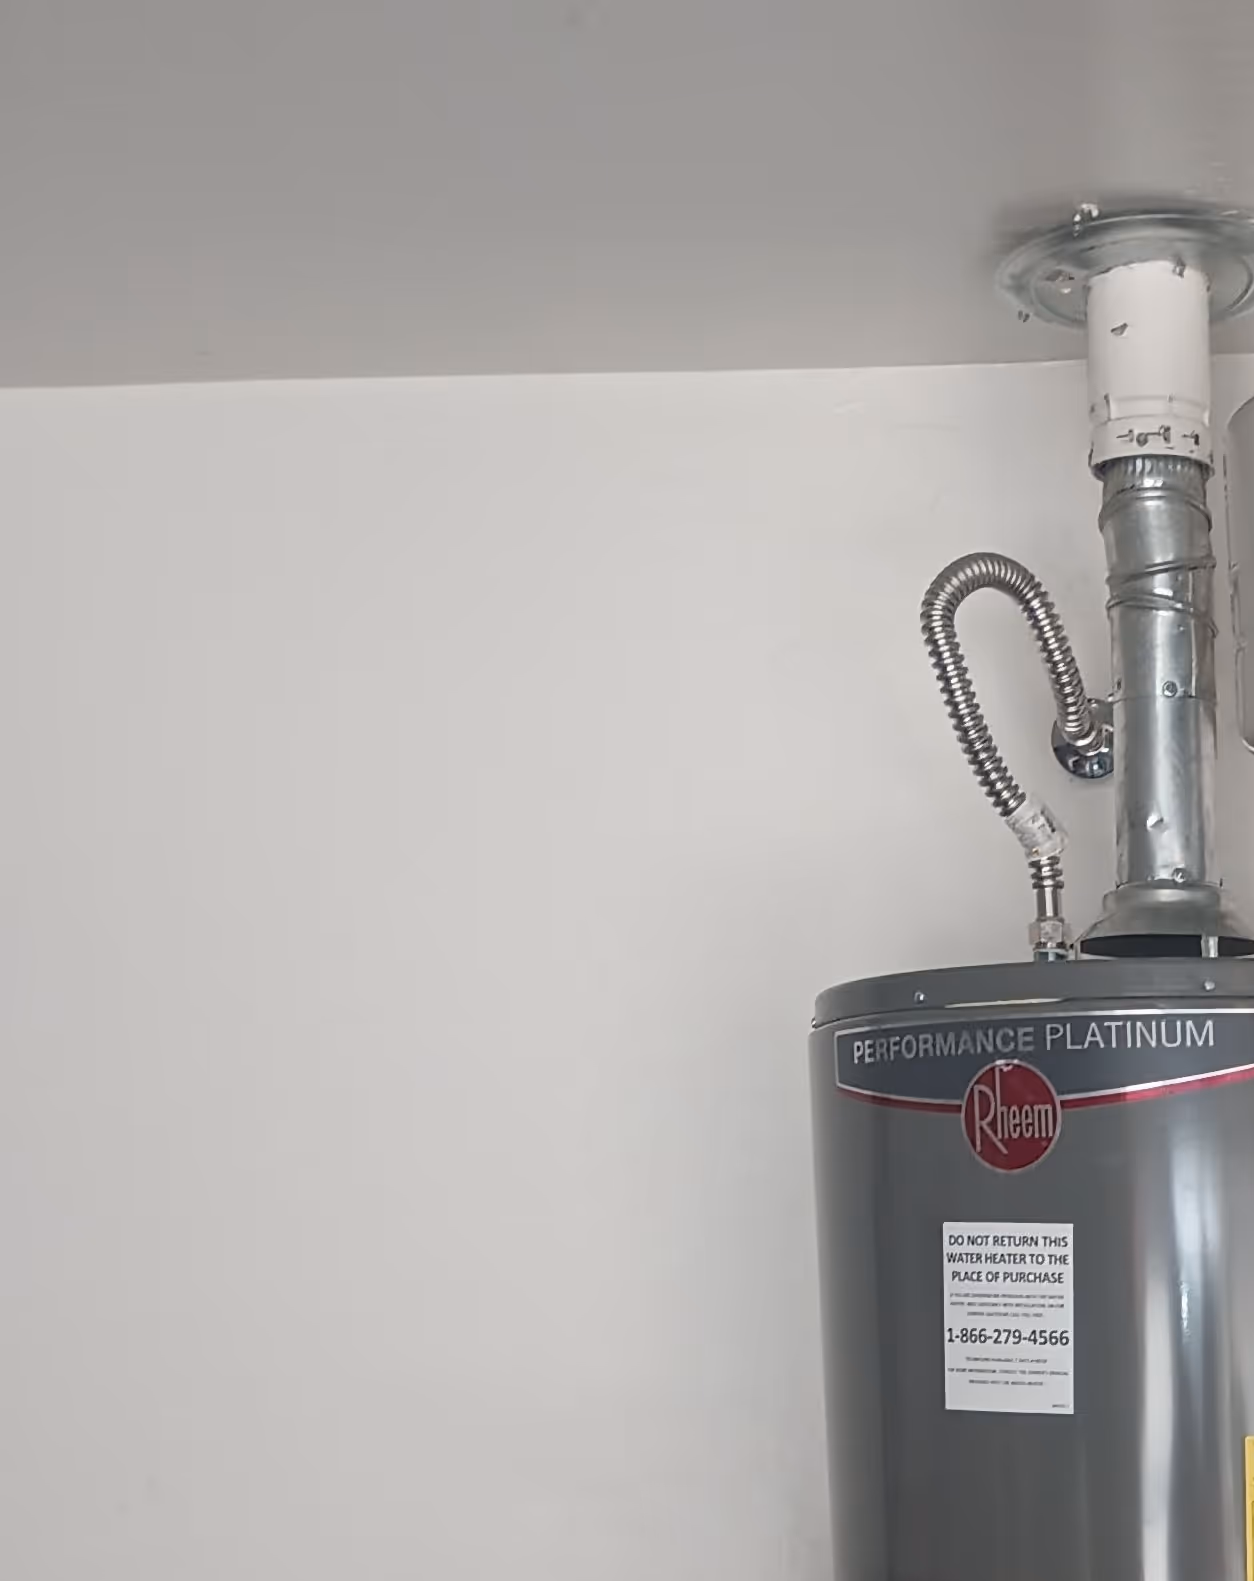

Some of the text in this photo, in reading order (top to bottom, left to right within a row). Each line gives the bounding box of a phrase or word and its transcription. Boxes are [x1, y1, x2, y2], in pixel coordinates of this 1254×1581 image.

[853, 1020, 1215, 1064] PERFORMANCE PLATINUM
[973, 1064, 1054, 1154] Rheem
[948, 1234, 1069, 1248] DO NOT RETURN THIS
[946, 1252, 1070, 1265] WATER HEATER TO THE
[951, 1270, 1065, 1284] PLACE OF PURCHASE
[946, 1327, 1070, 1346] 1-866-279-4566
